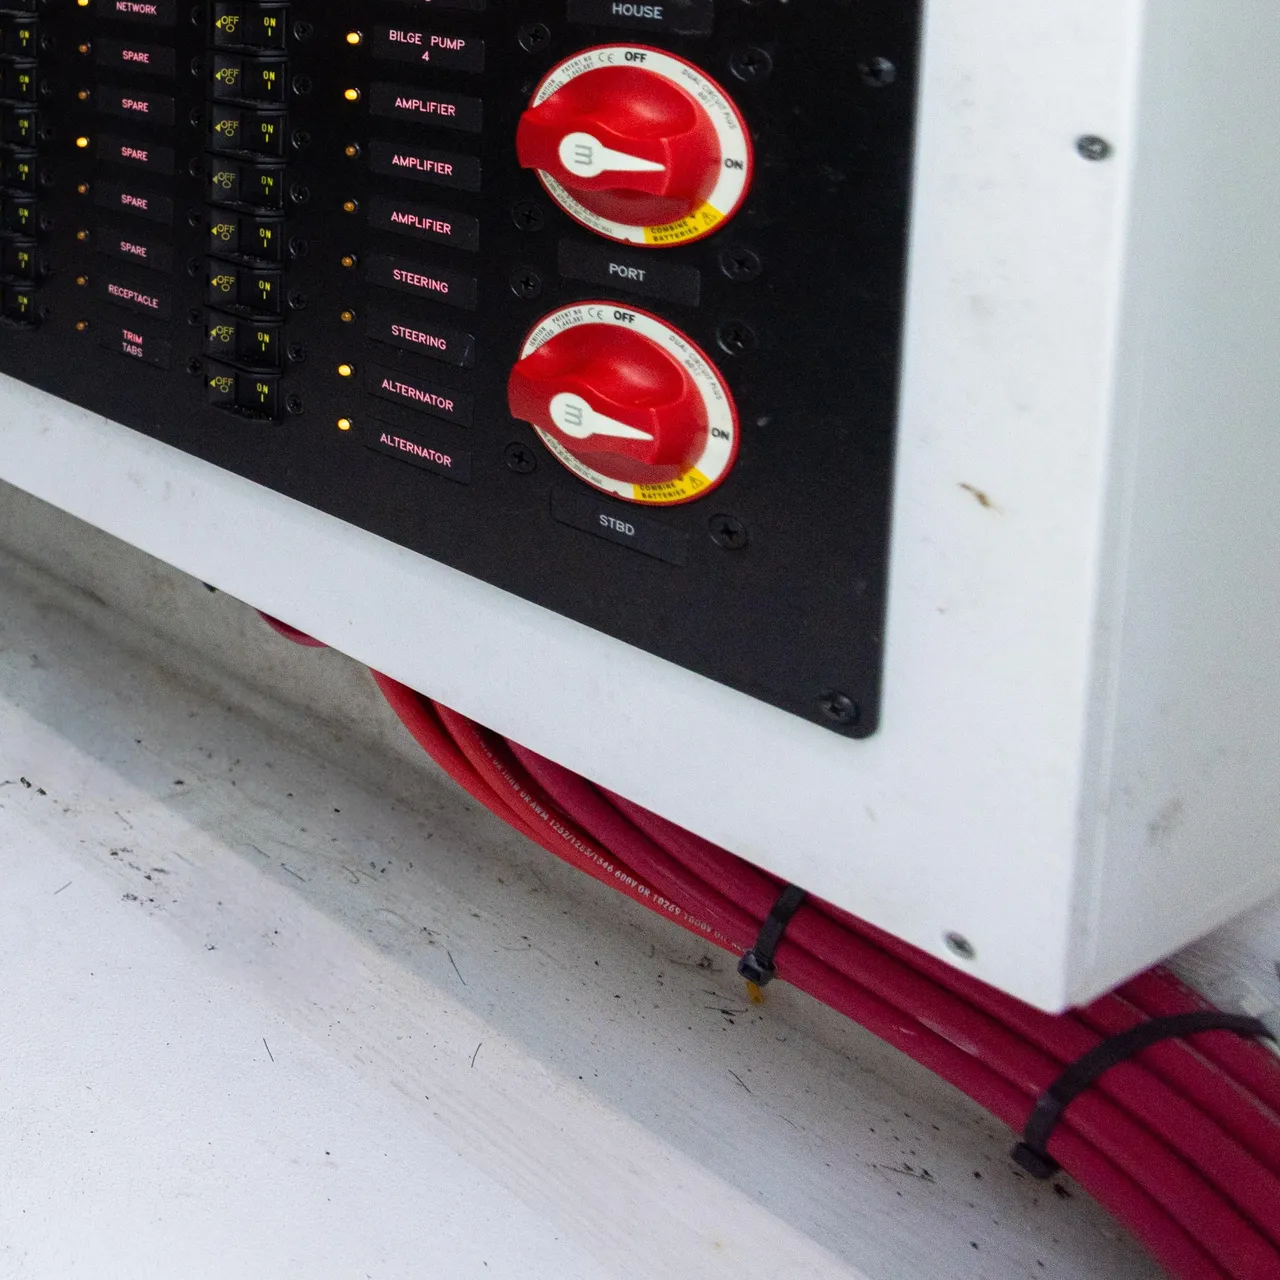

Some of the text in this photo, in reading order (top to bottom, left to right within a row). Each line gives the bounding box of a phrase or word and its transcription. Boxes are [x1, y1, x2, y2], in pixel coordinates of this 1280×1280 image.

[116, 2, 157, 15] NETWORK
[612, 2, 663, 20] HOUSE
[221, 15, 239, 25] OFF
[264, 18, 276, 26] ON
[389, 30, 465, 51] BILGE PUMP
[122, 50, 149, 63] SPARE
[421, 51, 430, 62] 4
[624, 51, 647, 63] OFF
[221, 68, 239, 78] OFF
[263, 71, 275, 80] ON
[122, 99, 149, 113] SPARE
[394, 97, 456, 117] AMPLIFIER
[221, 120, 239, 129] OFF
[262, 124, 273, 133] ON
[122, 147, 148, 161] SPARE
[392, 155, 453, 176] AMPLIFIER
[724, 158, 744, 170] ON
[218, 172, 236, 181] OFF
[262, 176, 273, 185] ON
[121, 194, 148, 209] SPARE
[217, 223, 235, 233] OFF
[391, 211, 452, 235] AMPLIFIER
[650, 220, 689, 234] COMBINE
[260, 229, 271, 238] ON
[652, 226, 699, 242] BATTERIES
[121, 242, 147, 258] SPARE
[609, 262, 646, 282] PORT
[217, 275, 235, 284] OFF
[259, 281, 270, 290] ON
[393, 269, 449, 294] STEERING
[108, 284, 159, 309] RECEPTACLE
[613, 310, 636, 324] OFF
[216, 325, 235, 334] OFF
[122, 329, 143, 345] TRIM
[258, 333, 269, 342] ON
[391, 325, 447, 351] STEERING
[122, 341, 143, 357] TABS
[668, 335, 688, 353] DUAL
[215, 375, 233, 385] OFF
[257, 384, 269, 393] ON
[381, 379, 454, 411] ALTERNATOR
[711, 428, 730, 442] ON
[379, 433, 452, 468] ALTERNATOR
[640, 481, 677, 492] COMBINE
[641, 488, 687, 499] BATTERIES
[599, 514, 635, 536] STBD
